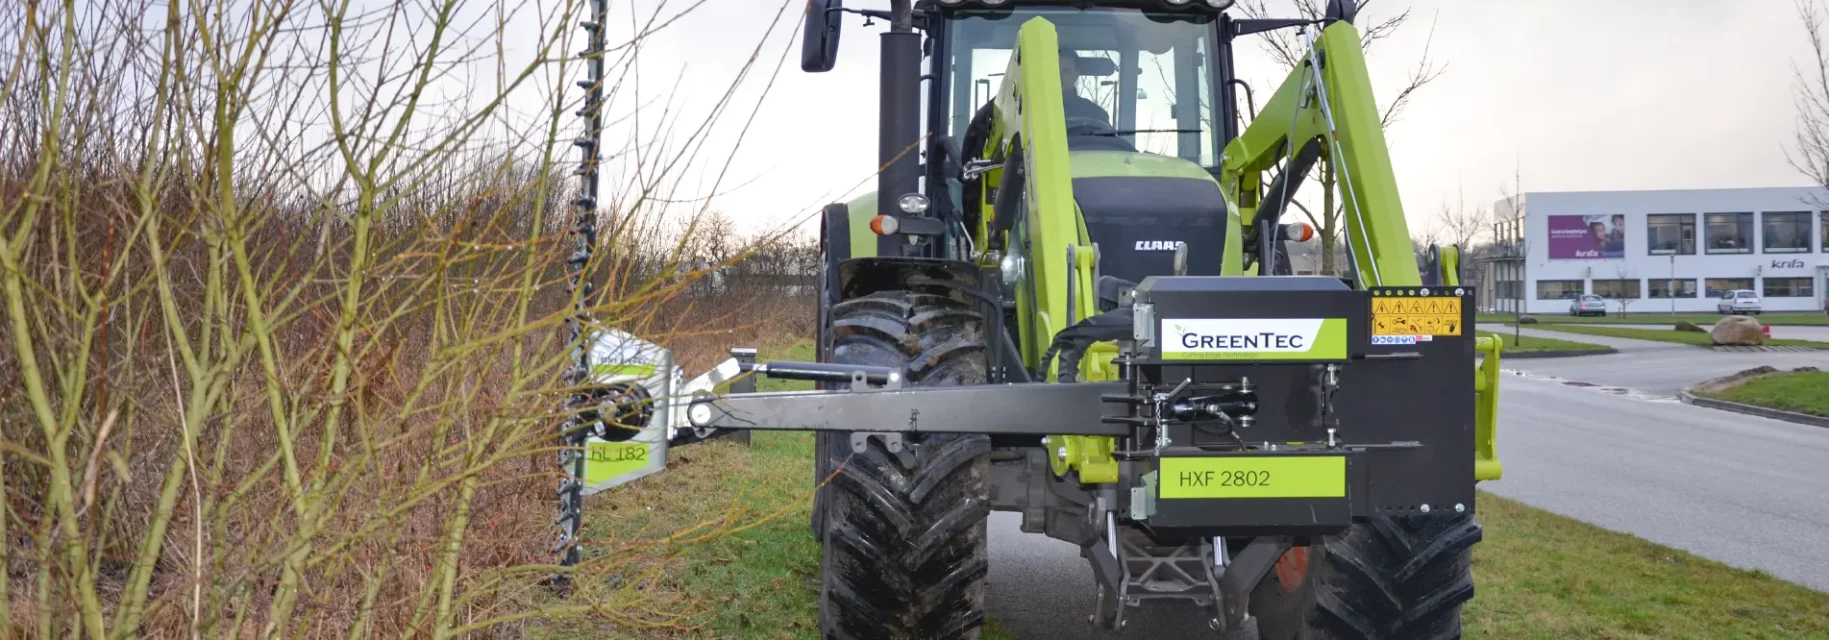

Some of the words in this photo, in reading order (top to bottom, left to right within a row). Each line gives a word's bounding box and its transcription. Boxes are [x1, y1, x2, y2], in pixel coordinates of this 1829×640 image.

[1771, 259, 1804, 269] krifa
[615, 447, 646, 461] 182
[1179, 471, 1215, 487] HXF
[1220, 470, 1271, 487] 2802
